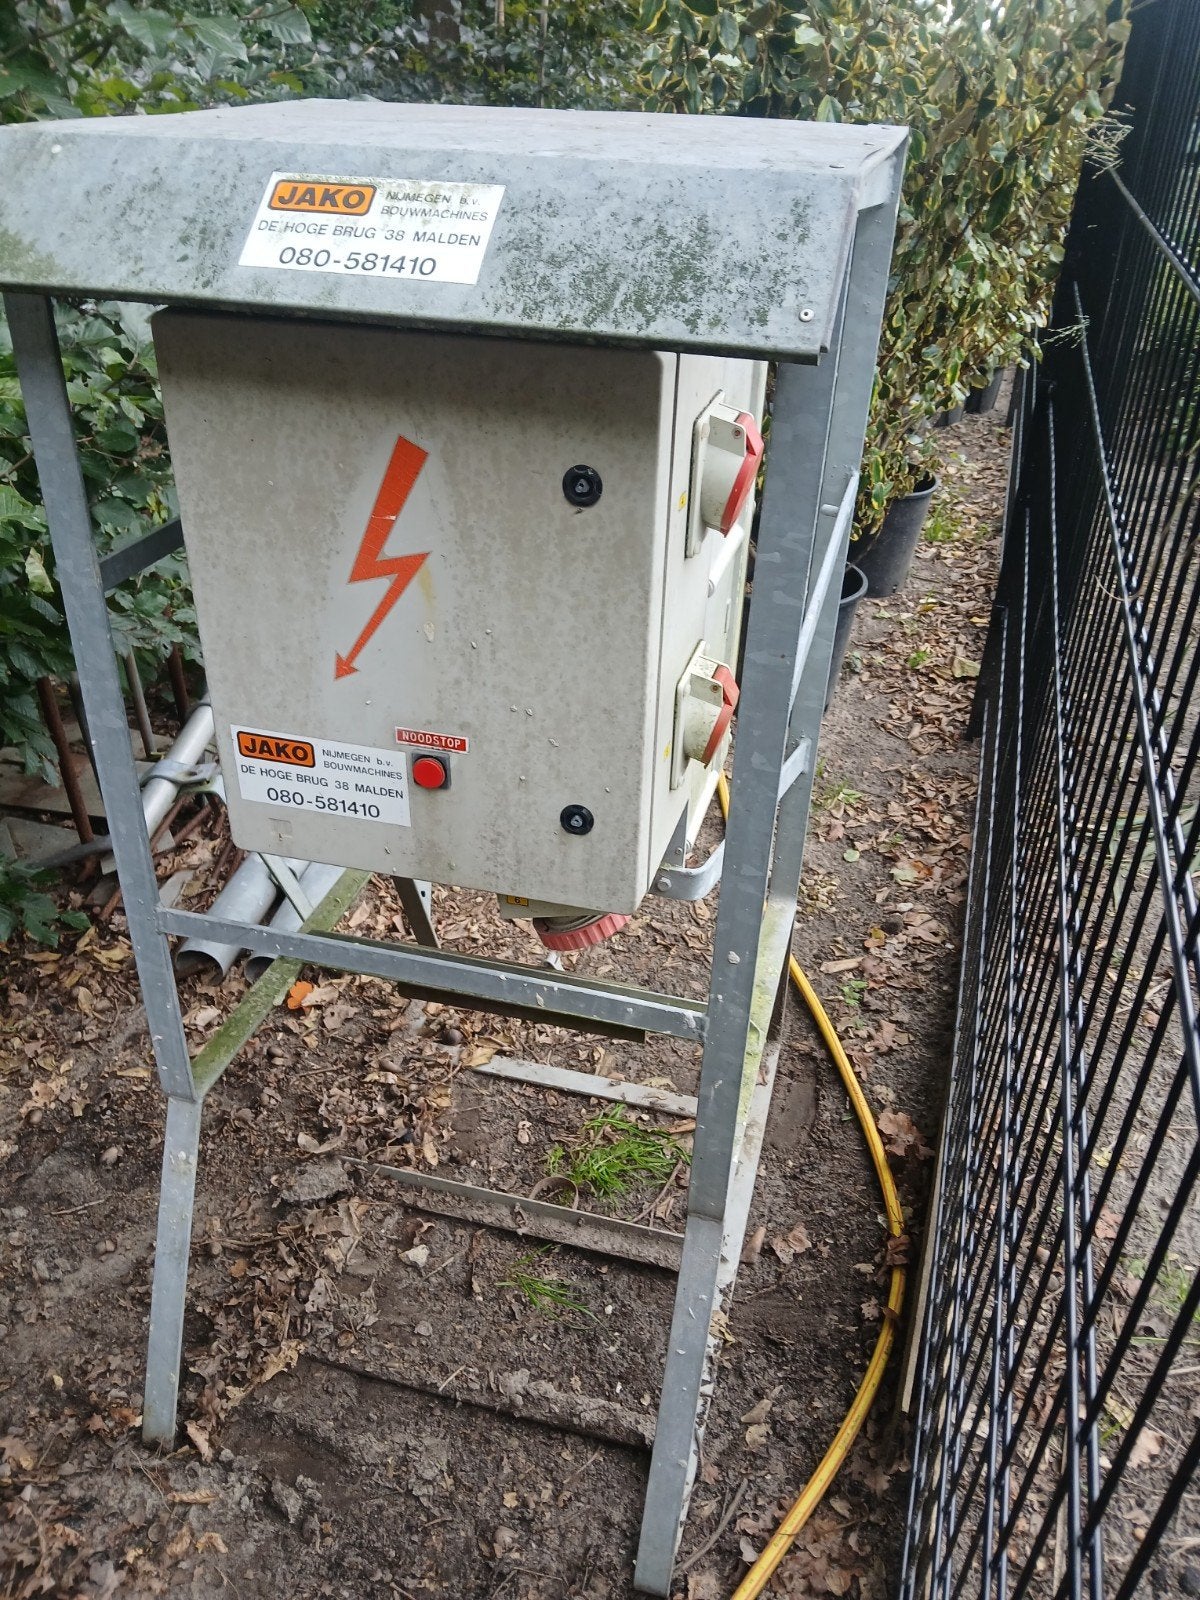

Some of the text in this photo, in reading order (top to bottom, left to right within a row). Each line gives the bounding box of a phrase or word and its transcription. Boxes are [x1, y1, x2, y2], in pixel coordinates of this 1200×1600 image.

[278, 186, 367, 209] JAKO
[385, 192, 452, 204] NIJMEGEN
[380, 205, 489, 222] BOUWMACHINES
[257, 220, 482, 247] DE HOGE BRUG 38 MALDEN
[278, 246, 437, 276] 080-581410
[244, 738, 309, 762] JAKO
[402, 730, 461, 748] NOODSTOP
[322, 749, 371, 763] NIJMEGEN
[240, 764, 404, 799] DE HOGE BRUG 38 MALDEN
[323, 761, 403, 780] BOUWMACHINES
[266, 787, 381, 818] 080-581410
